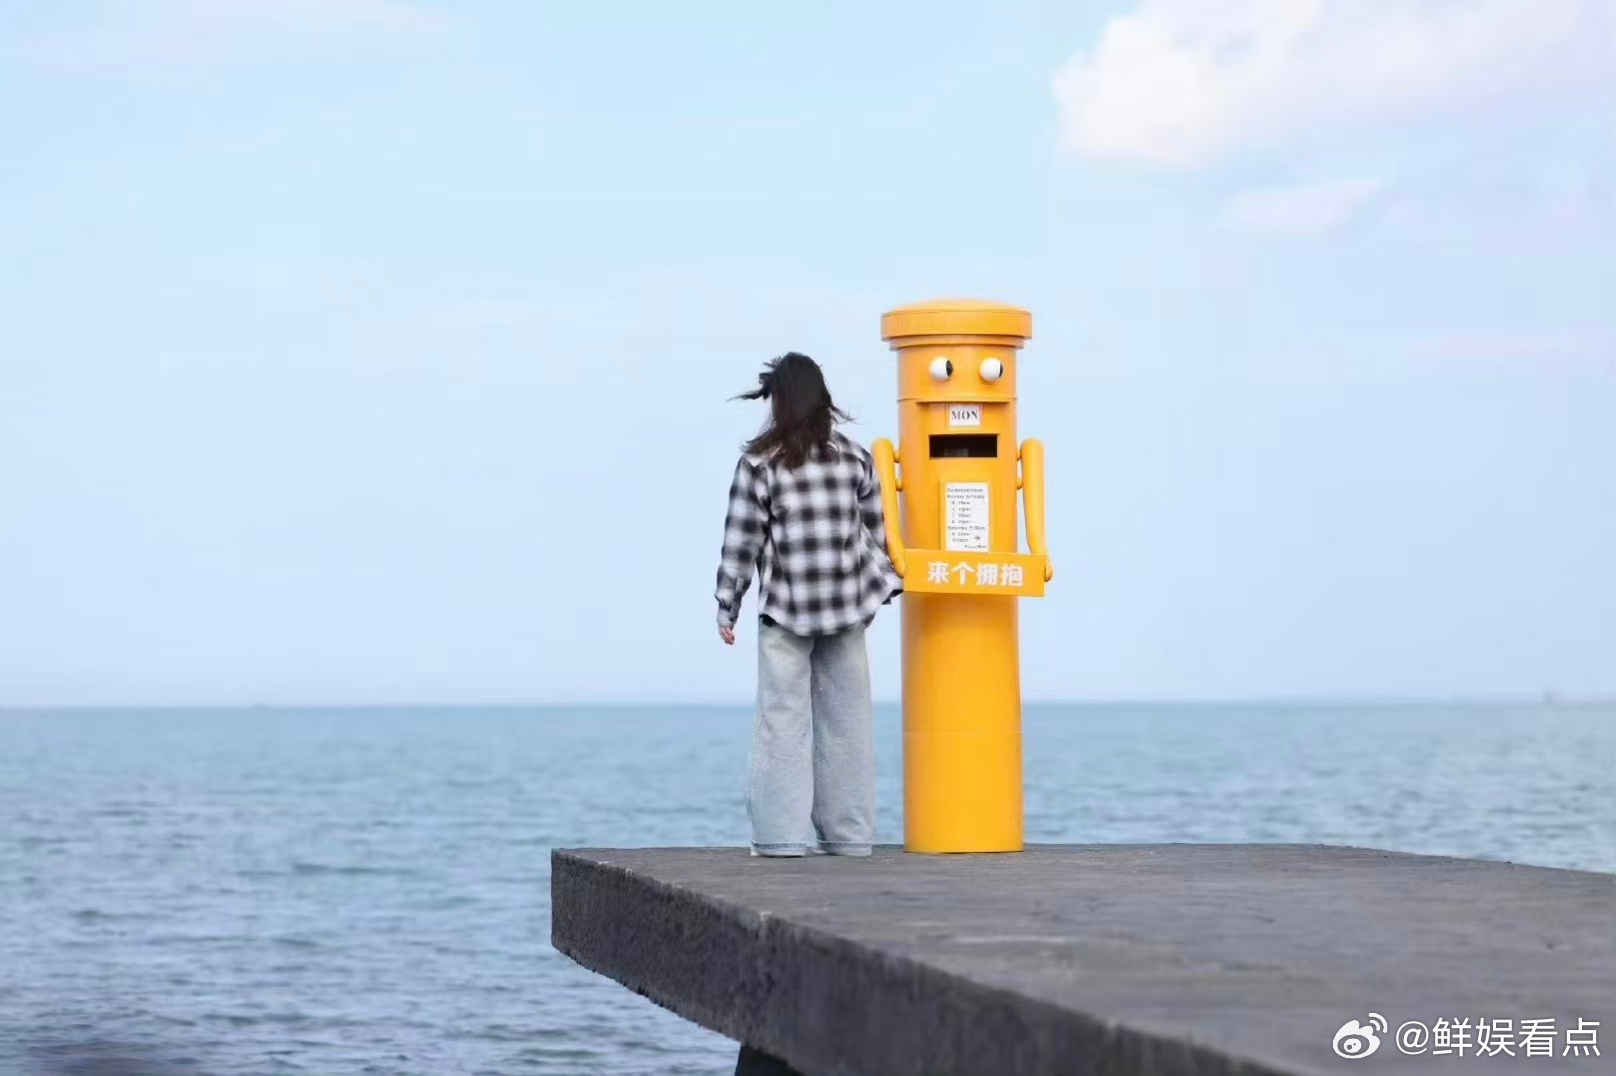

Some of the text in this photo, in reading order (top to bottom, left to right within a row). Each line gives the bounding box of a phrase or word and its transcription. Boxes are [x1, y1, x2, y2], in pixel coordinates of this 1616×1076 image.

[951, 410, 978, 421] MON
[928, 561, 1024, 587] 来个拥抱
